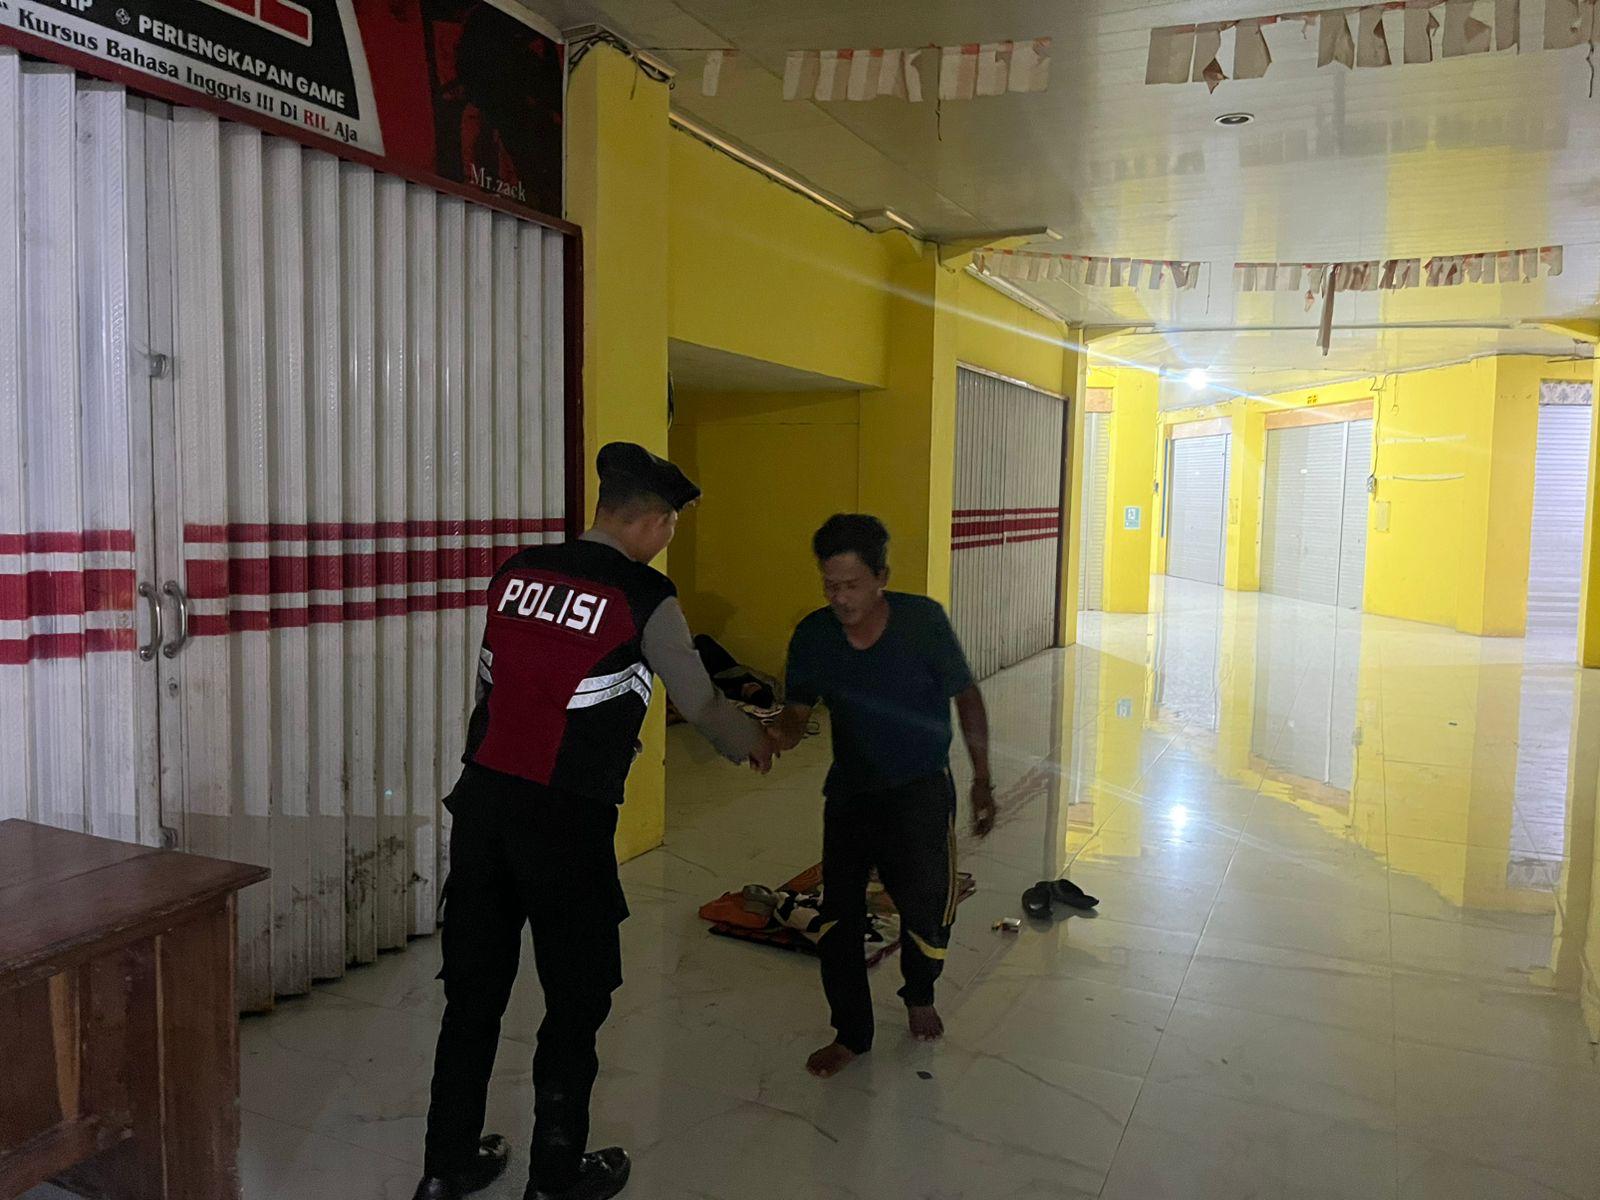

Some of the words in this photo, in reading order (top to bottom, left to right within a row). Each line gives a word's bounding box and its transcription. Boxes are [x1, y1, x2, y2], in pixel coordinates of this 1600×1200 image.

[18, 7, 99, 51] Kursus
[106, 37, 179, 80] Bahasa
[186, 65, 251, 104] Inggris
[280, 100, 298, 121] Di
[303, 108, 330, 132] RIL
[334, 121, 359, 143] Aja
[138, 14, 293, 90] PERLENGKAPAN
[296, 73, 345, 107] GAME
[497, 578, 608, 635] POLISI
